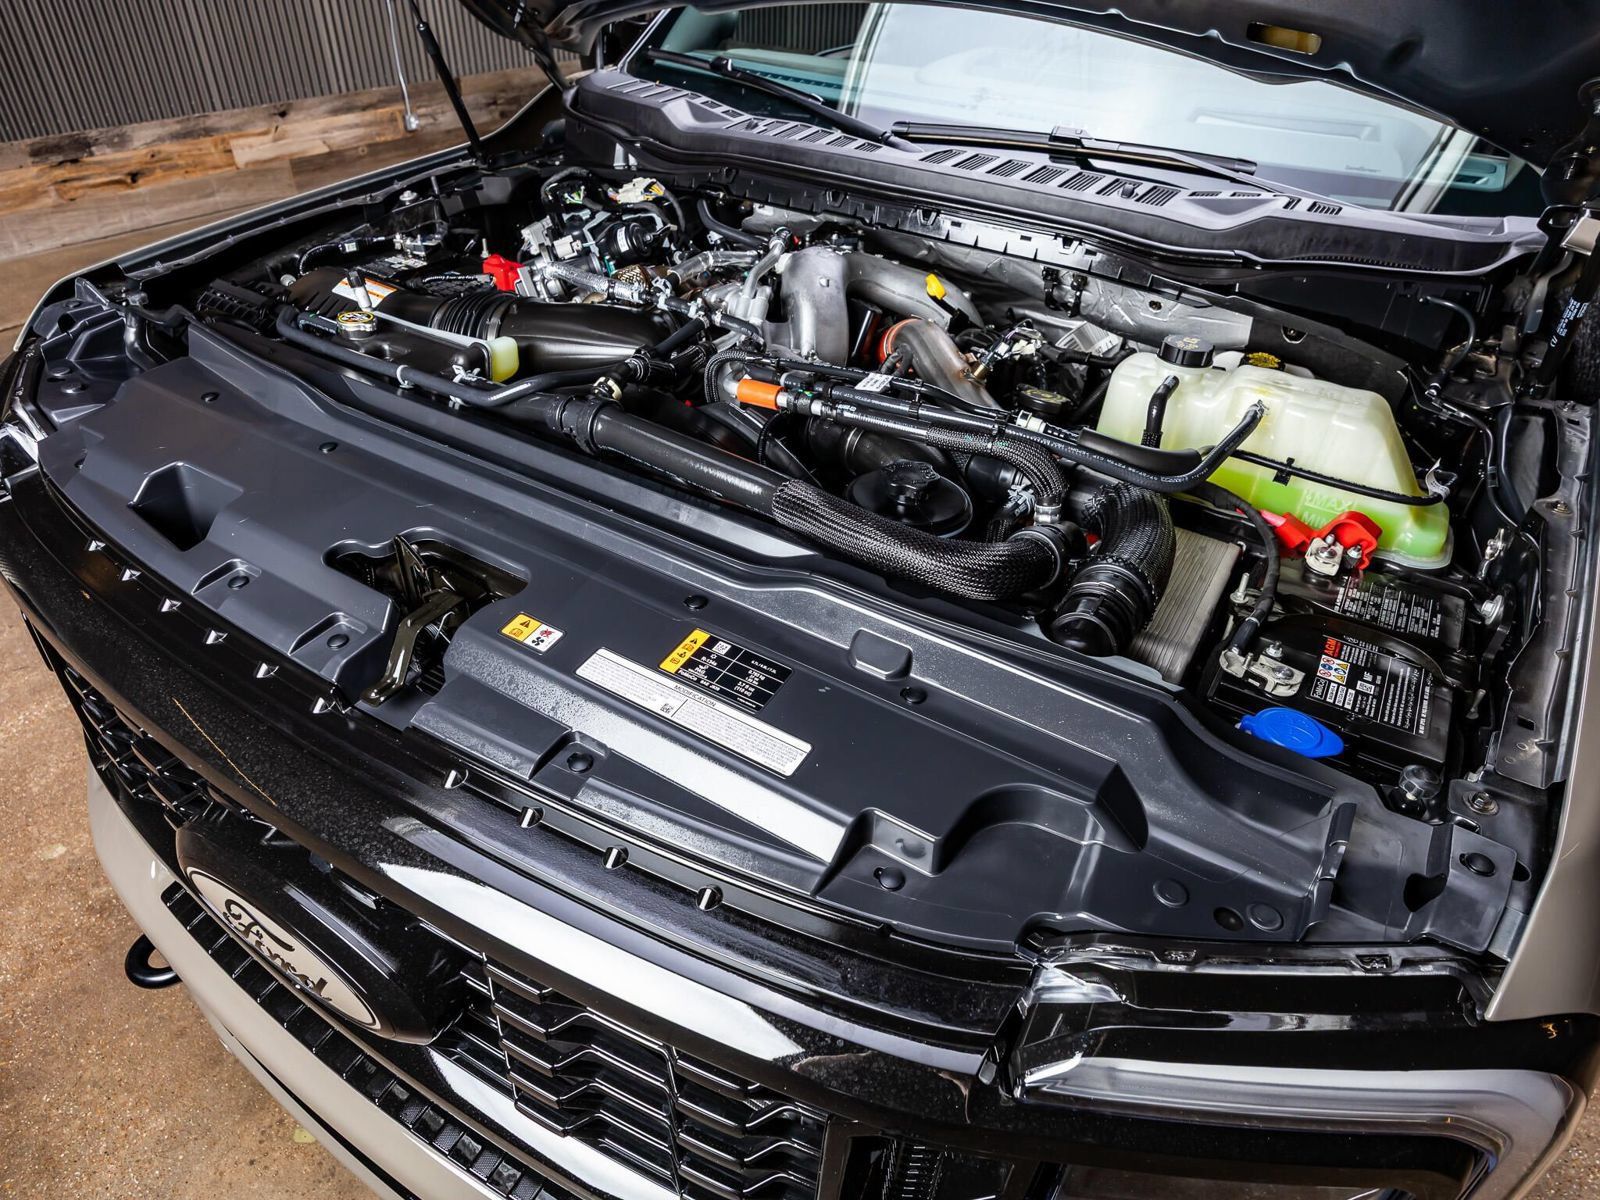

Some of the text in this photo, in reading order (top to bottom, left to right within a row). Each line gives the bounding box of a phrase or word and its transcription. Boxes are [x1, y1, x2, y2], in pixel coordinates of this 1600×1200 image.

[1324, 638, 1337, 656] AGM
[674, 684, 717, 707] MODIFICATION
[1313, 679, 1325, 697] FoMoCo
[223, 899, 333, 1001] Ford
